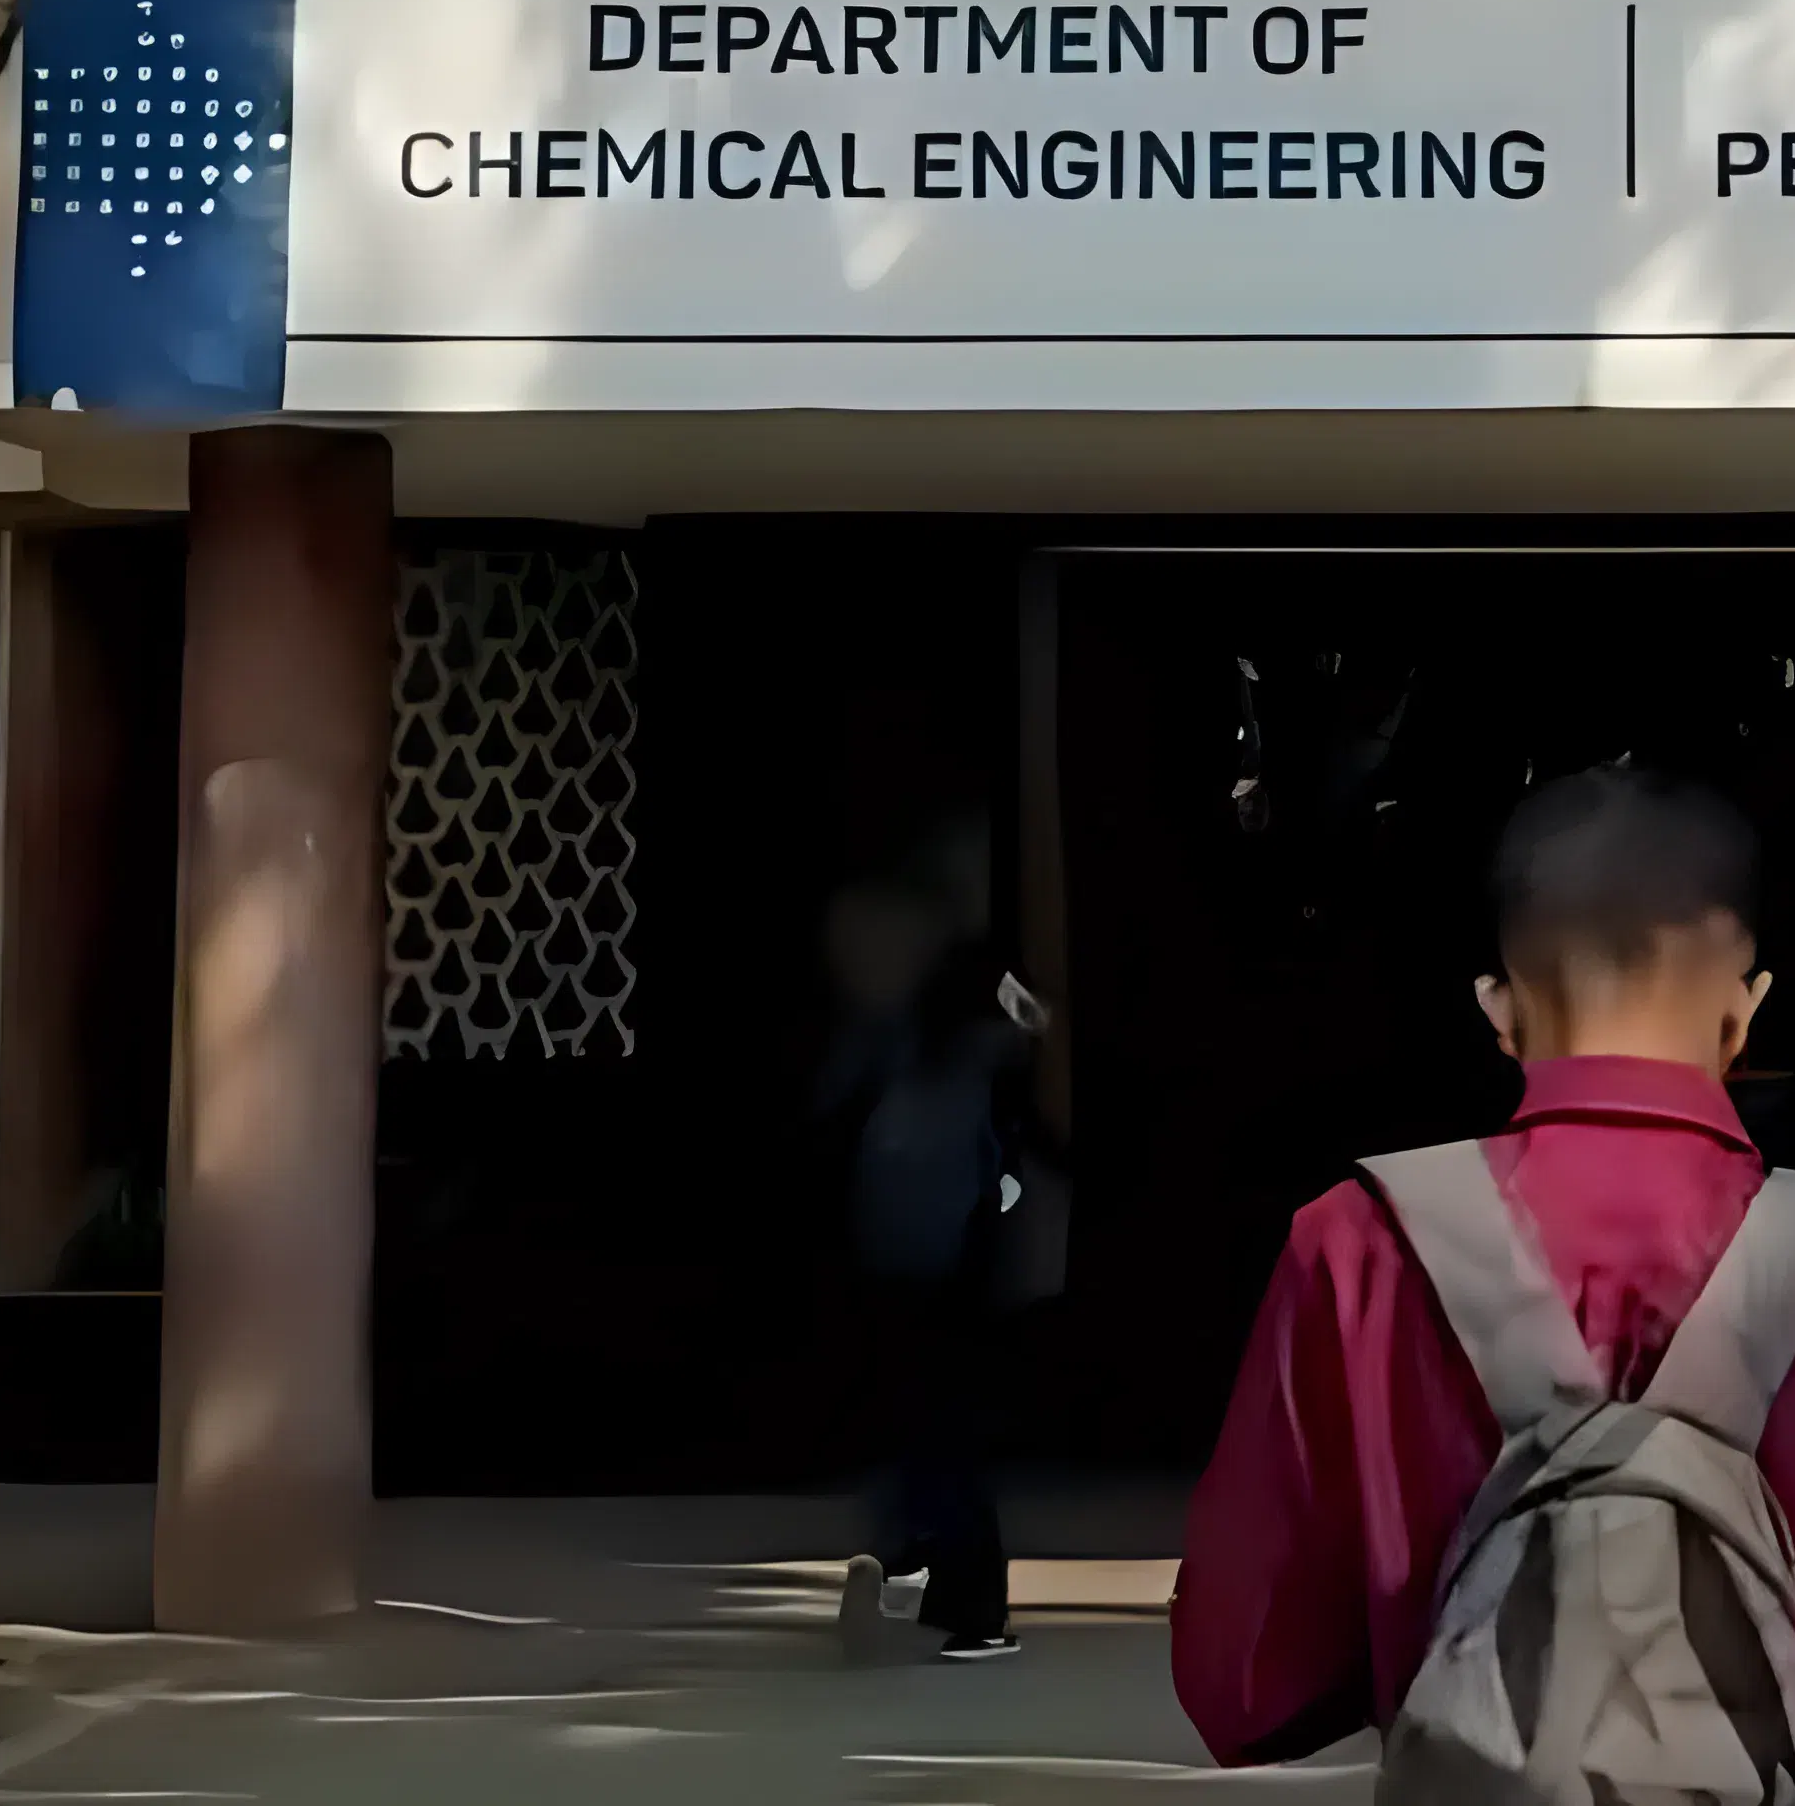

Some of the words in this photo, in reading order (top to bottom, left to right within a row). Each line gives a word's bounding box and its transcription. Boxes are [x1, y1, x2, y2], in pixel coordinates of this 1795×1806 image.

[588, 3, 1230, 76] DEPARTMENT
[1251, 5, 1370, 76] OF
[397, 127, 887, 201] CHEMICAL
[912, 128, 1547, 201] ENGINEERING
